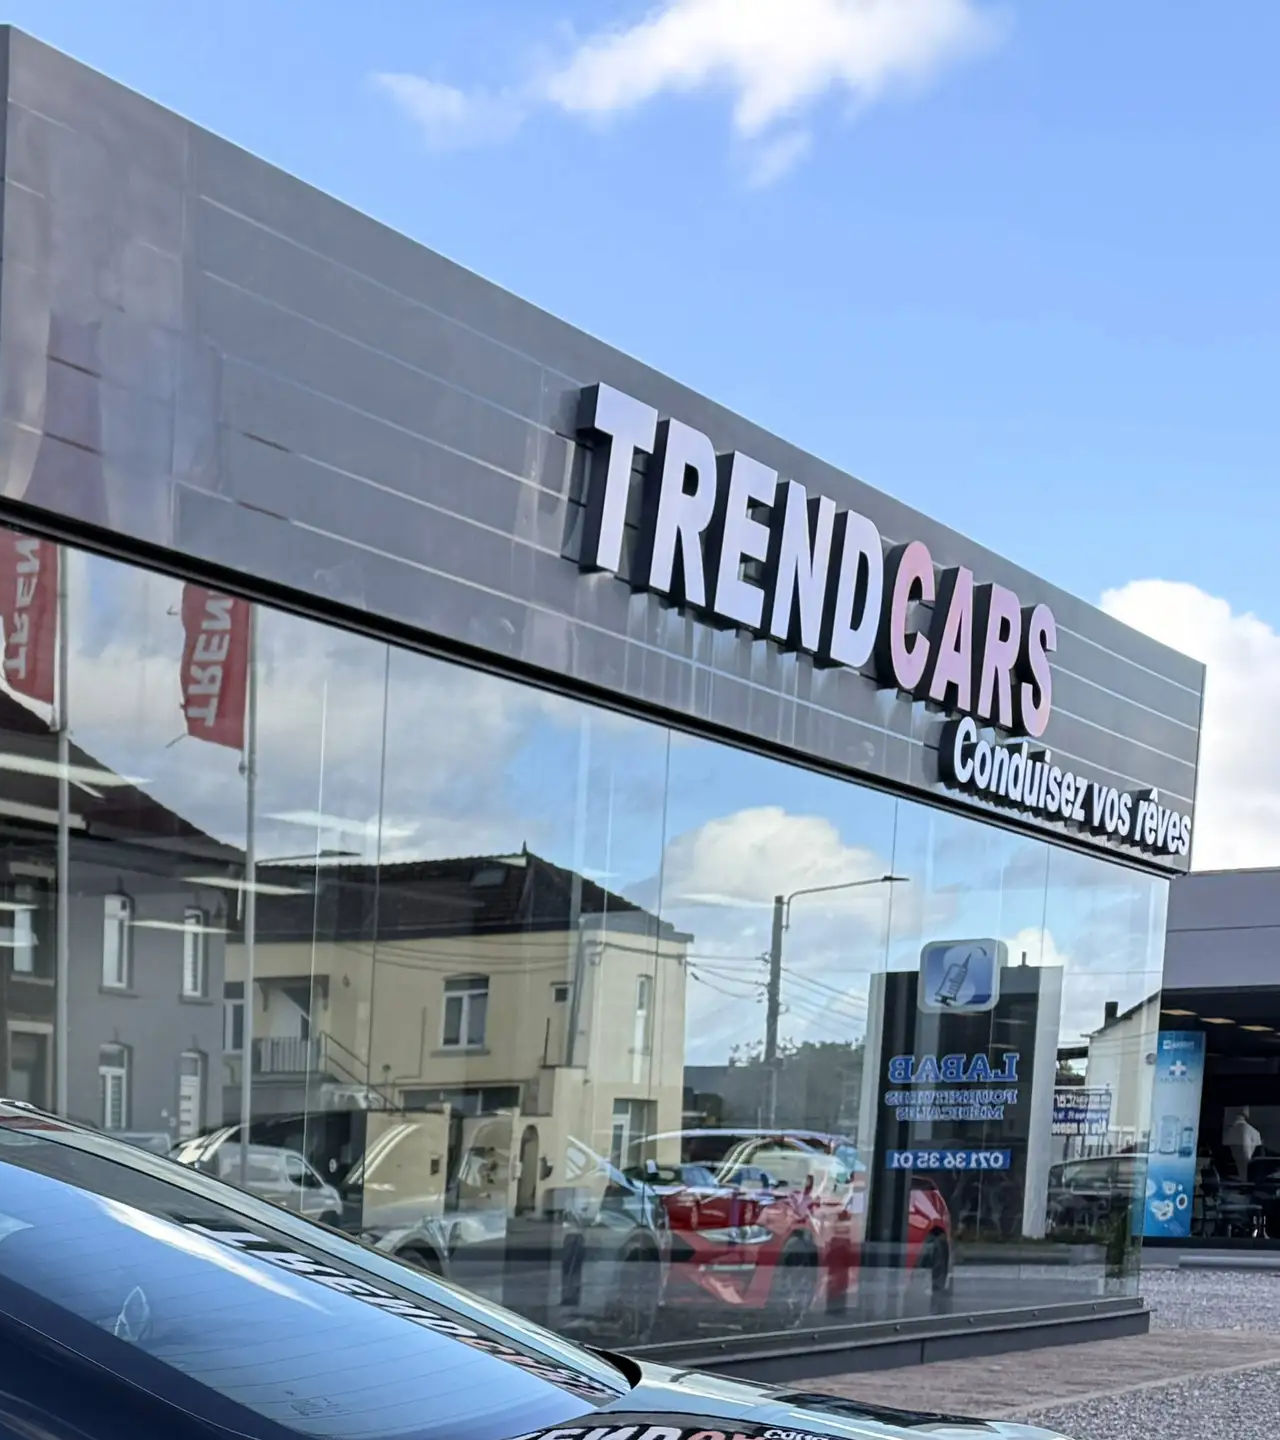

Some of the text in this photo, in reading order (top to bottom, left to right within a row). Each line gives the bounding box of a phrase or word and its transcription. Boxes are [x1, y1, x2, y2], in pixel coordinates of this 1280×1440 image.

[594, 381, 1058, 738] TREND CARS
[952, 716, 1192, 856] Conduisez vos rêves
